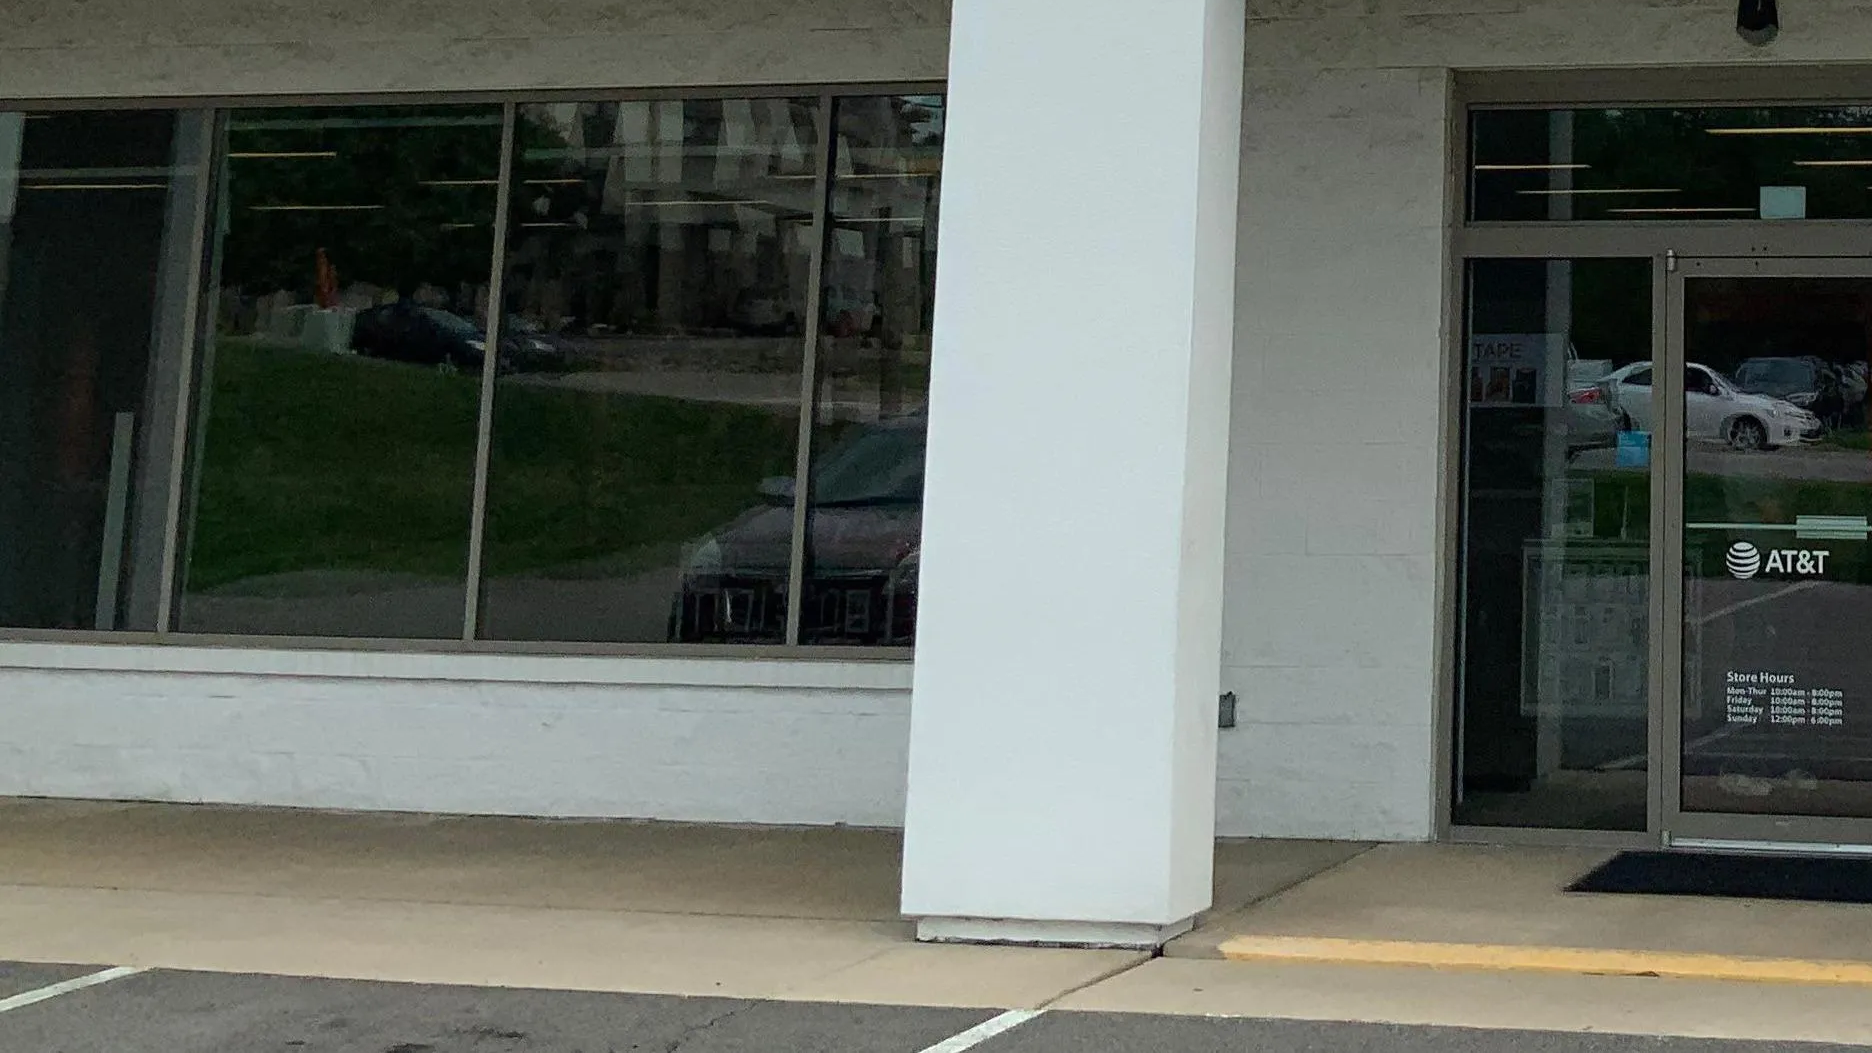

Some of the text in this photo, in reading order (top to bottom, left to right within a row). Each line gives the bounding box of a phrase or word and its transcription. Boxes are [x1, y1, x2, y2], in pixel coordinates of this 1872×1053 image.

[1765, 549, 1830, 574] AT&T
[1727, 671, 1795, 683] Store Hours
[1771, 688, 1805, 696] 10:00am
[1727, 696, 1752, 705] Friday
[1771, 697, 1805, 705] 10:00am
[1727, 705, 1764, 715] Saturday
[1727, 714, 1758, 723] Sunday
[1771, 715, 1805, 725] 12:00pm
